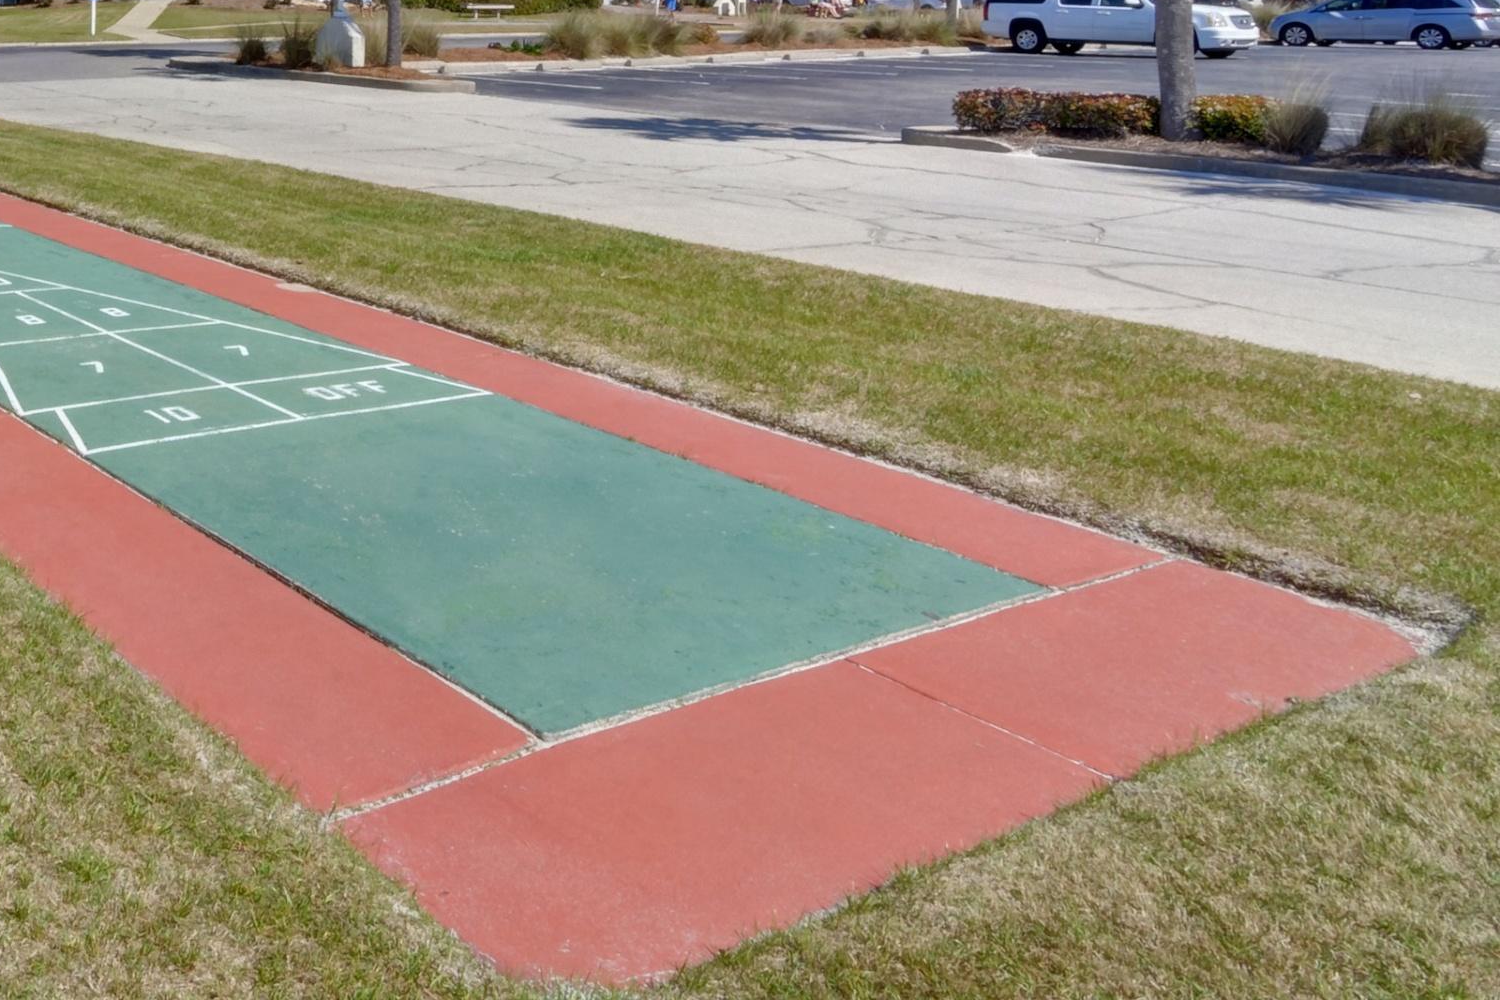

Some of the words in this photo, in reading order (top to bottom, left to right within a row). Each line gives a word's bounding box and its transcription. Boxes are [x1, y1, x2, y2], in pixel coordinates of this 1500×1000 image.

[99, 307, 131, 317] 8
[15, 314, 47, 325] 8
[223, 345, 249, 357] 7
[79, 361, 104, 373] 7
[143, 406, 201, 423] 10
[302, 380, 386, 400] OFF
